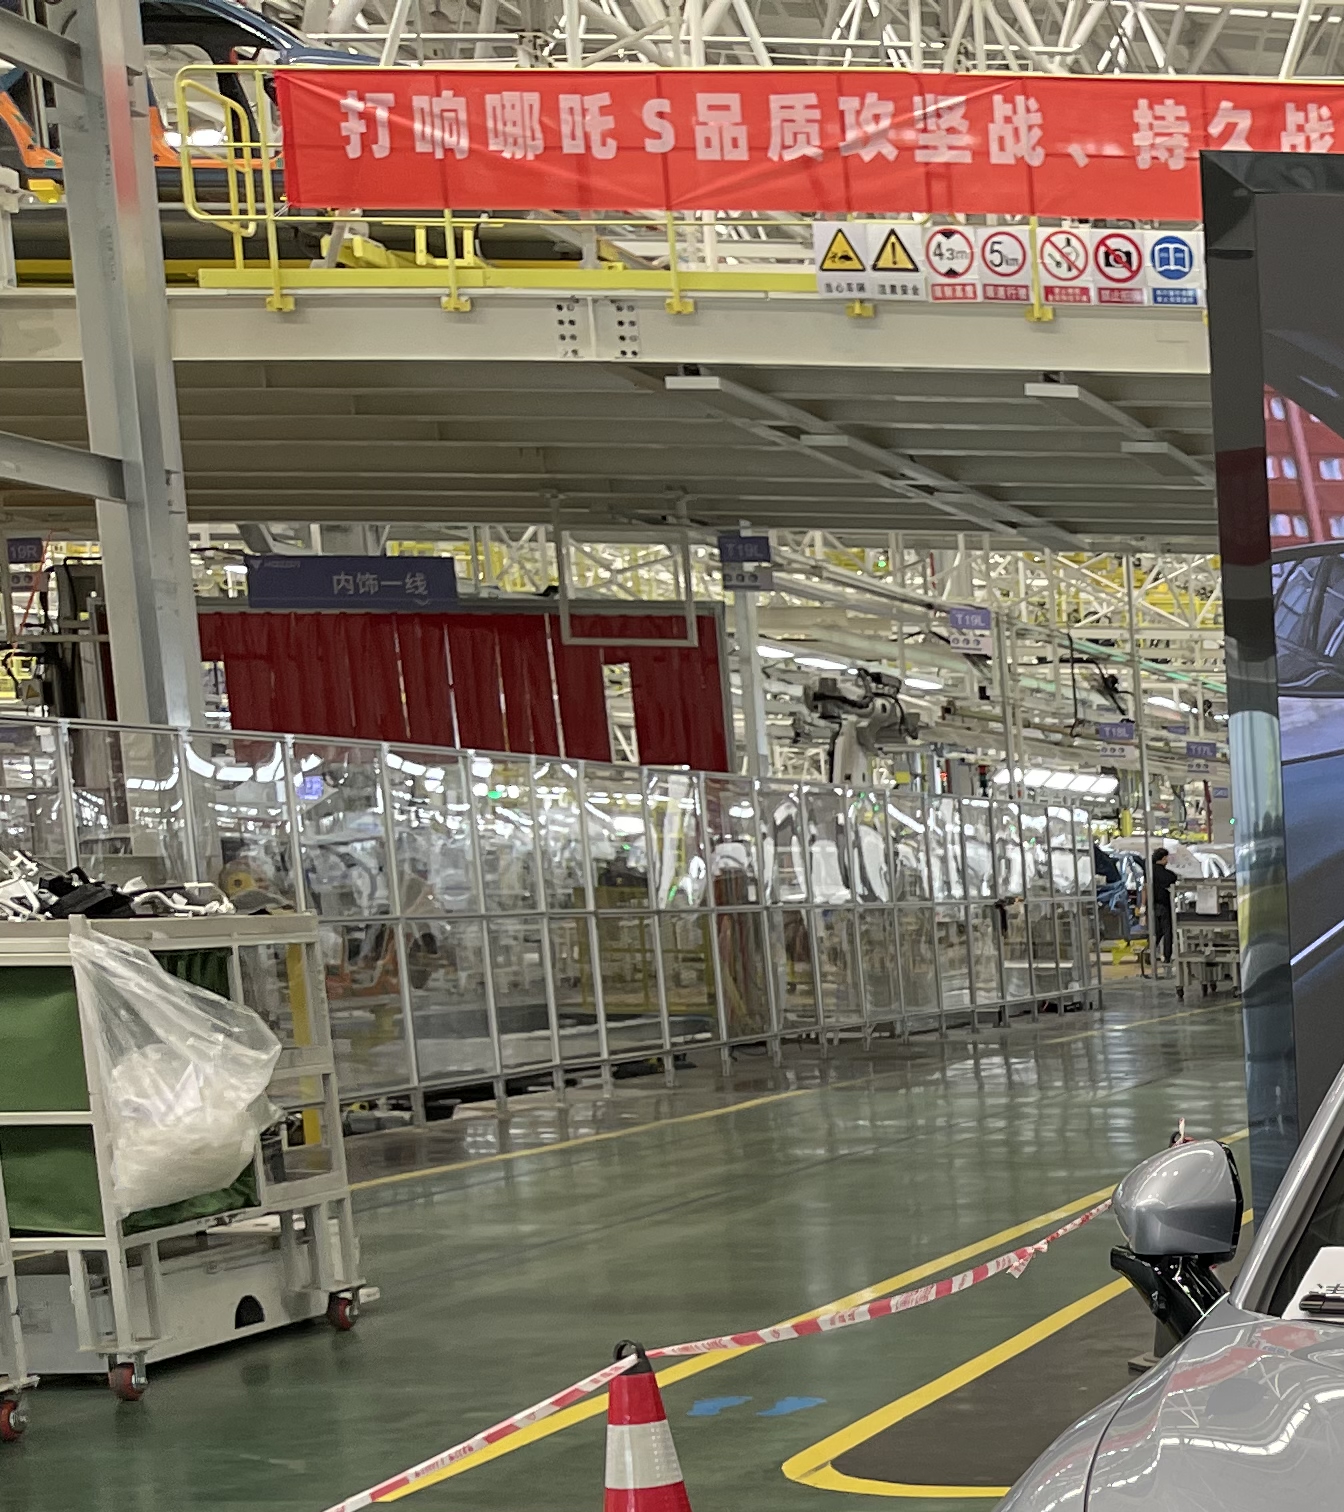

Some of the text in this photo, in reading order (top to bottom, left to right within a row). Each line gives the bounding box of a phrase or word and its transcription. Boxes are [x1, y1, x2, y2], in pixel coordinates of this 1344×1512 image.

[332, 572, 430, 596] 内饰一线
[955, 613, 986, 627] T19L
